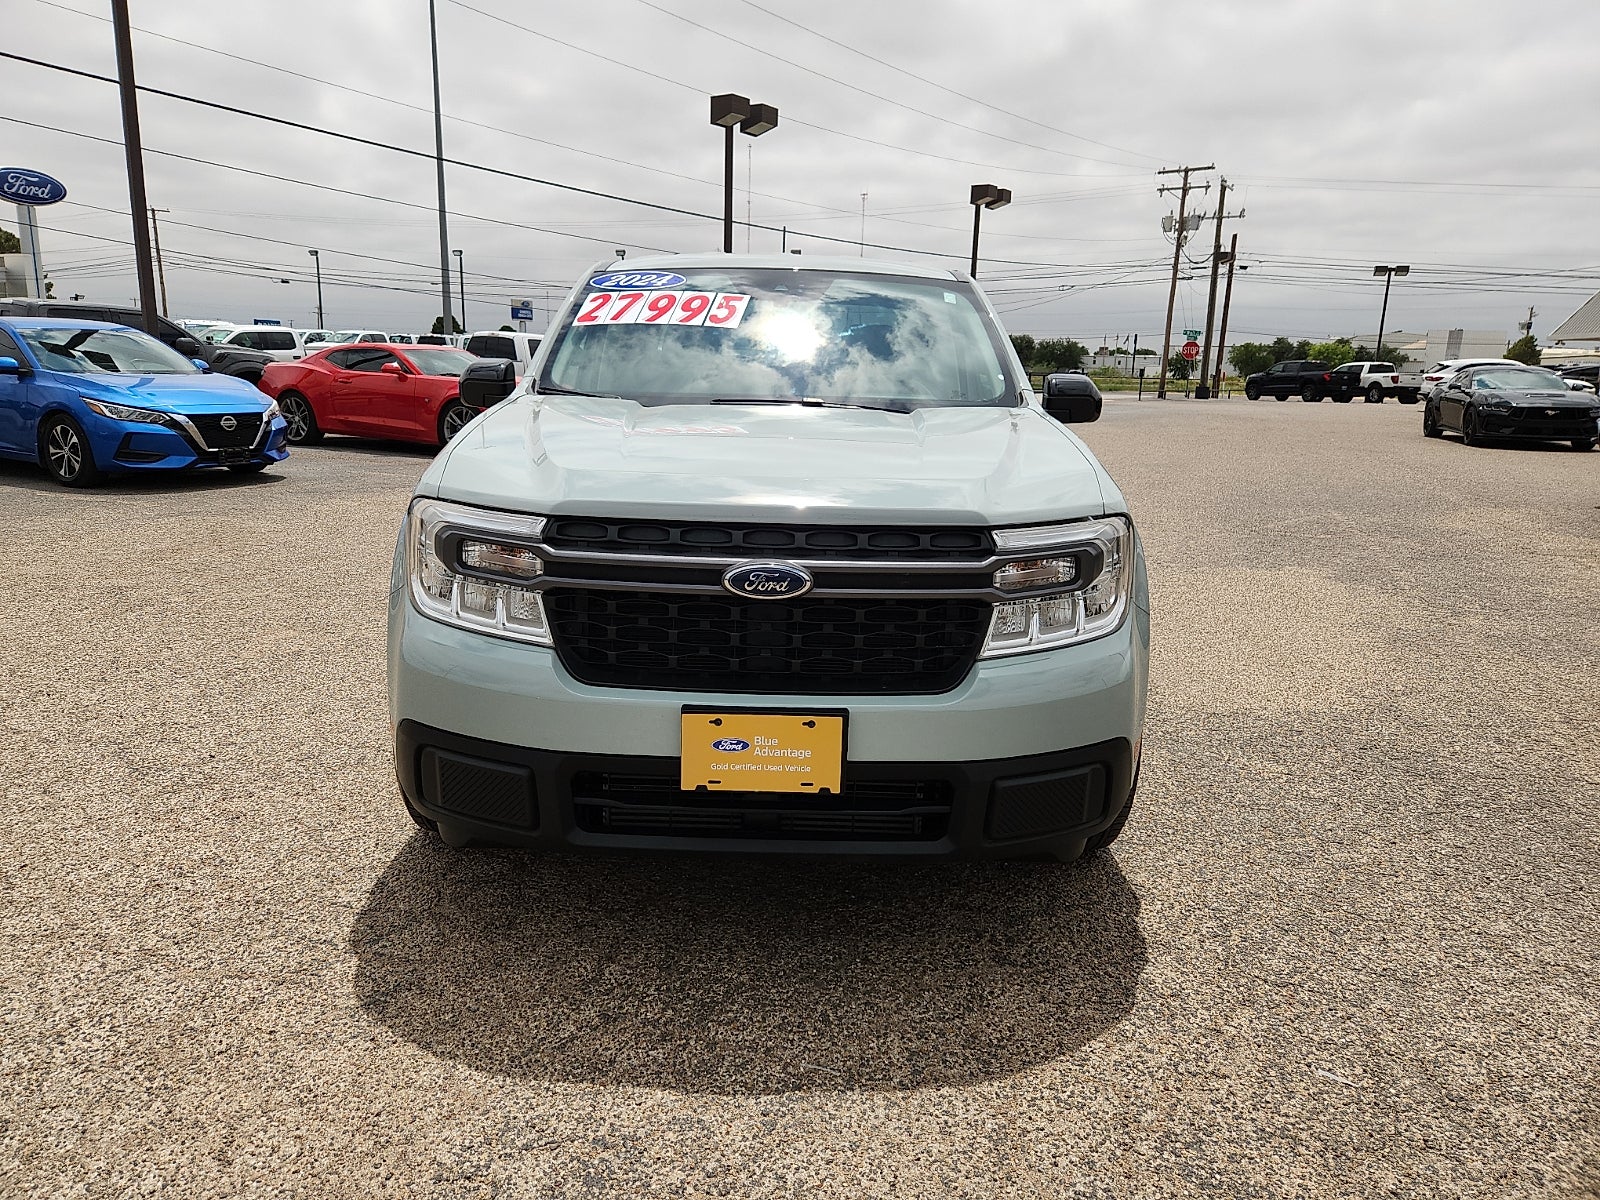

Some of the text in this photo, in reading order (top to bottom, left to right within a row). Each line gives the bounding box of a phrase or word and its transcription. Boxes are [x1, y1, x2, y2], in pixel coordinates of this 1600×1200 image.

[4, 173, 51, 198] Ford
[602, 274, 671, 287] 2024
[577, 293, 744, 324] 27995
[1183, 346, 1199, 354] STOP
[744, 571, 791, 592] Ford
[718, 740, 743, 751] Ford
[754, 735, 778, 746] Blue
[753, 747, 812, 759] Advantage
[730, 763, 762, 771] Certified
